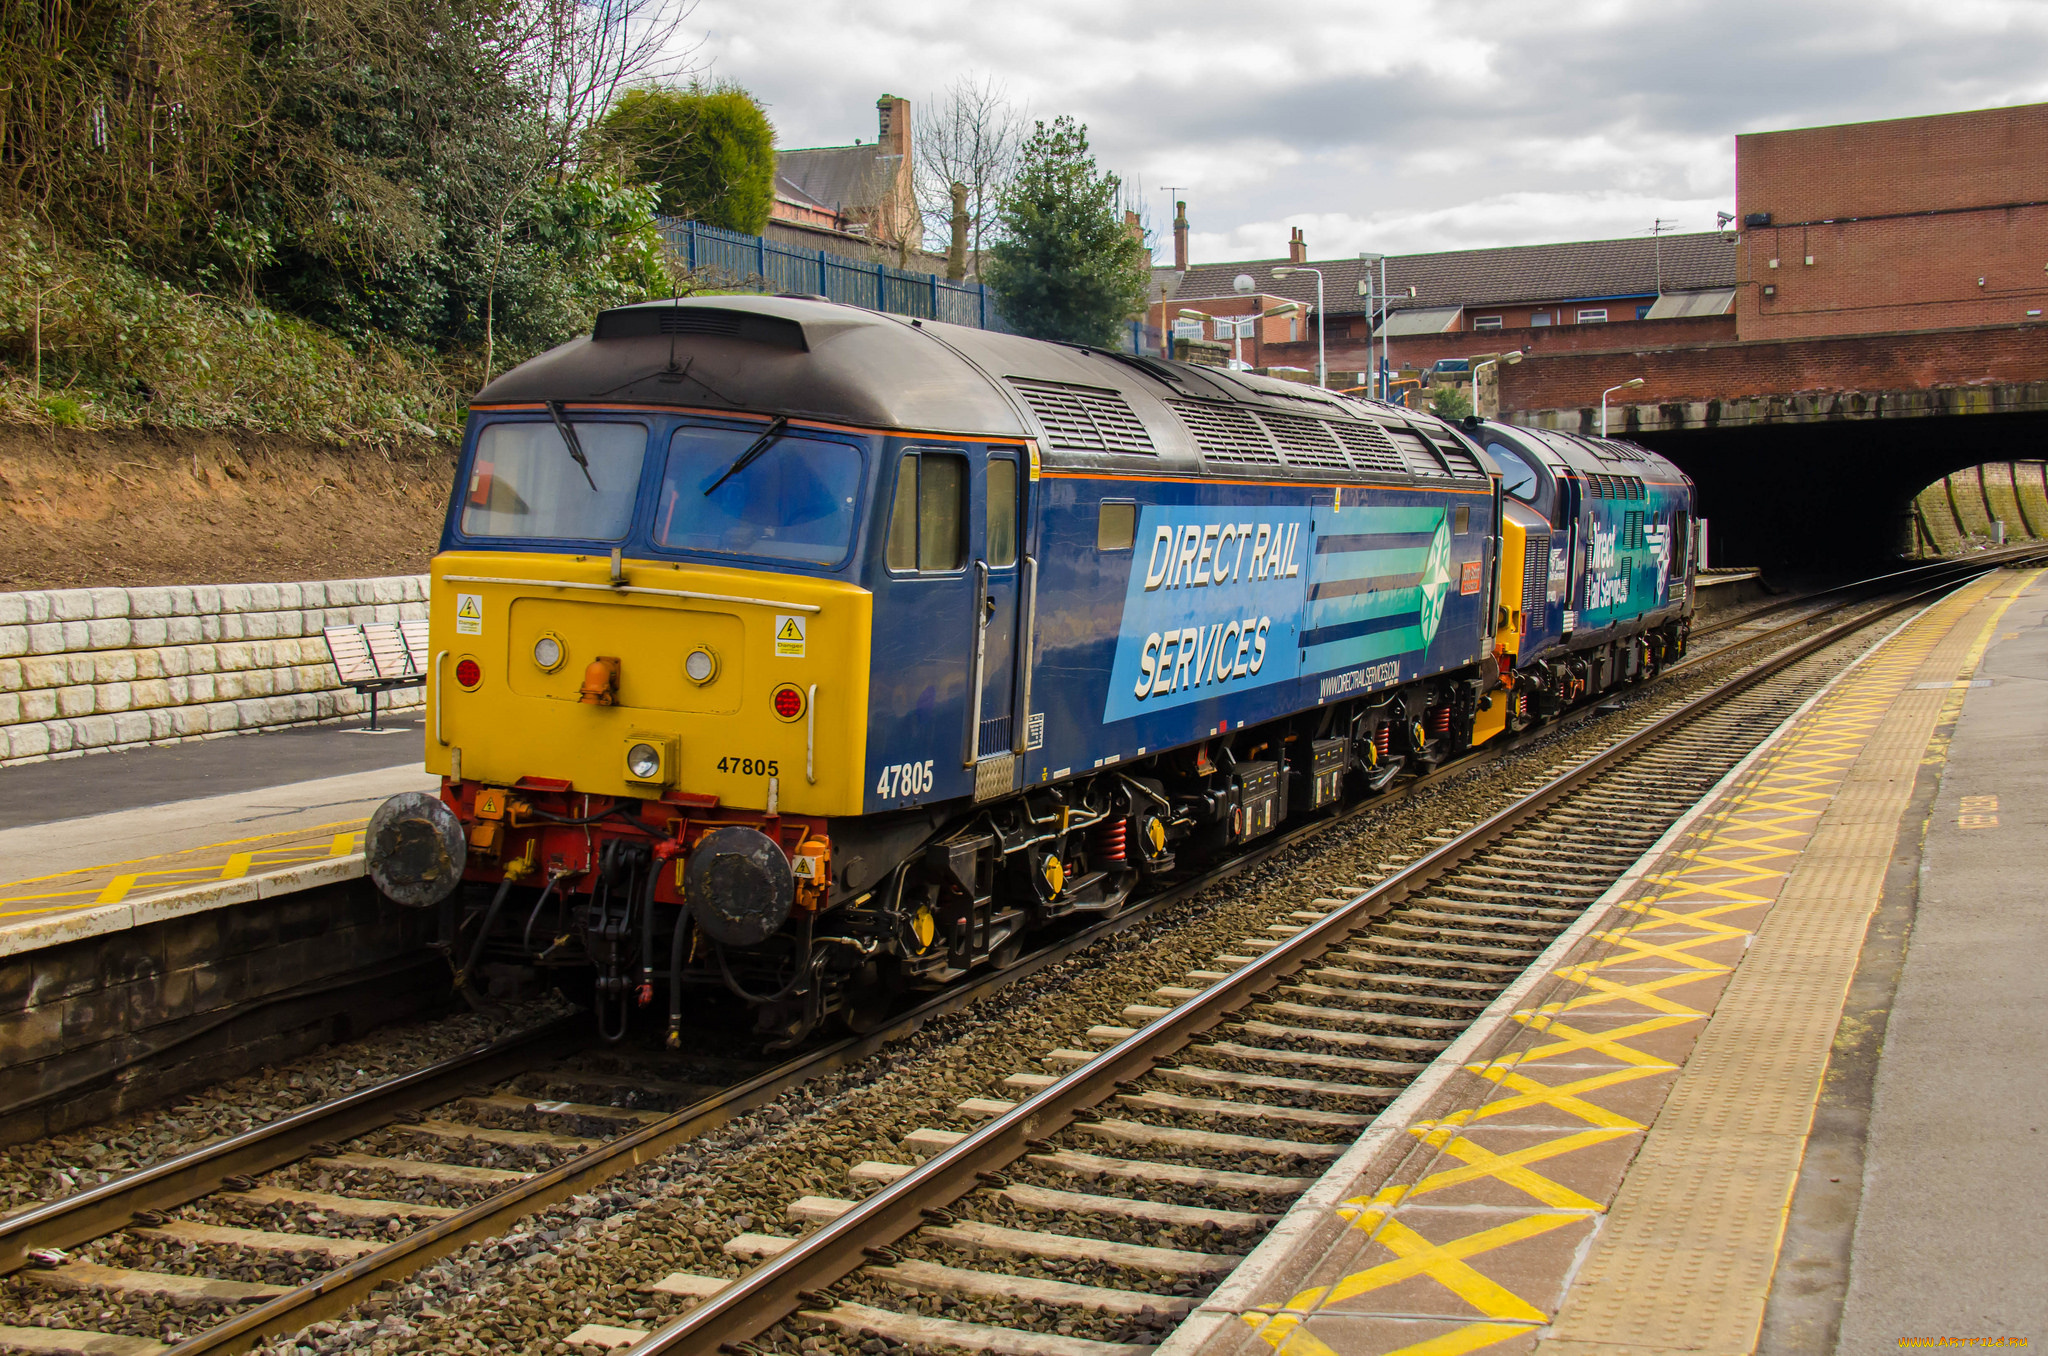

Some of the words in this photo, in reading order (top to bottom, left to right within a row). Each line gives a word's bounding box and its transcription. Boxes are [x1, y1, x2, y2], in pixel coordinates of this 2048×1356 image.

[1144, 521, 1253, 592] DIRECT
[1248, 522, 1300, 582] RAIL
[1134, 616, 1271, 701] SERVICES
[717, 757, 779, 777] 47805
[877, 760, 934, 800] 47805
